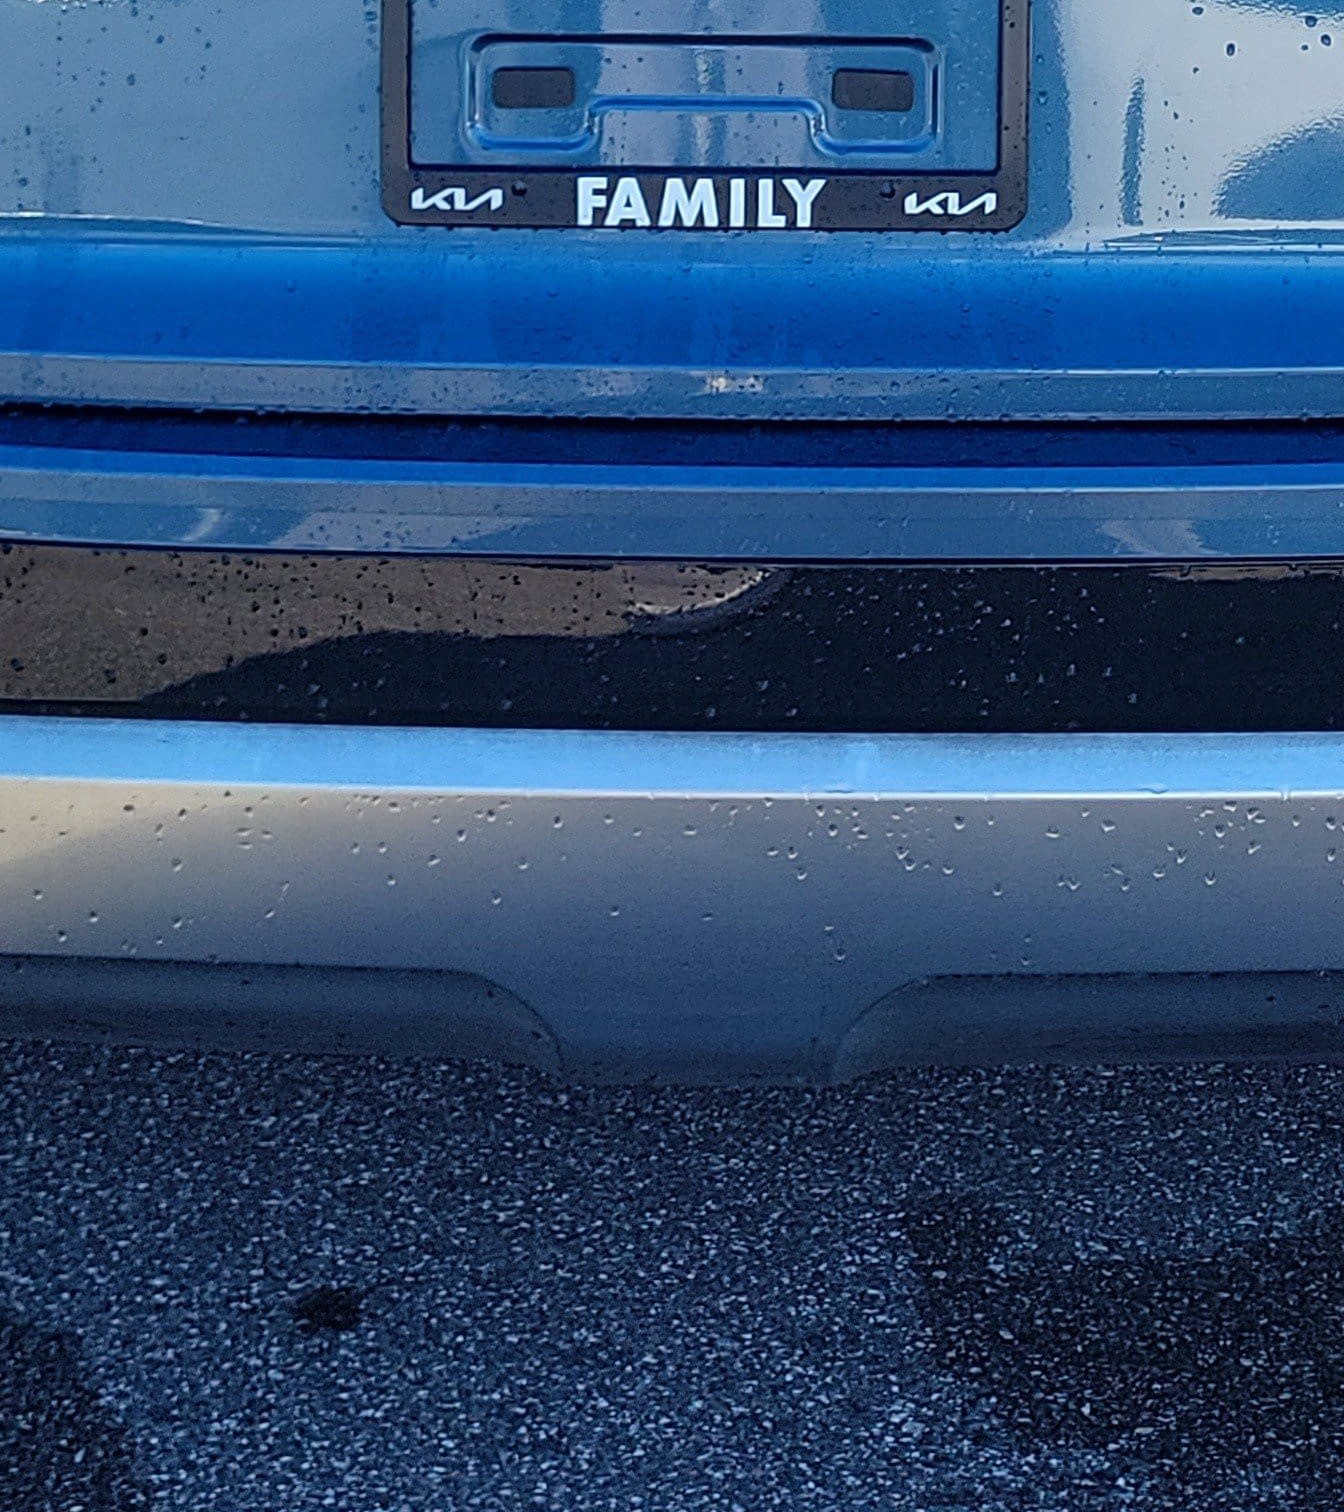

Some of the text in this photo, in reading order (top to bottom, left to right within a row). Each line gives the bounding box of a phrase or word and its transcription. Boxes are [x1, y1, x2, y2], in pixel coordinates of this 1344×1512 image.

[411, 185, 504, 212] KIA
[575, 176, 827, 229] FAMILY
[903, 191, 997, 217] KIA
